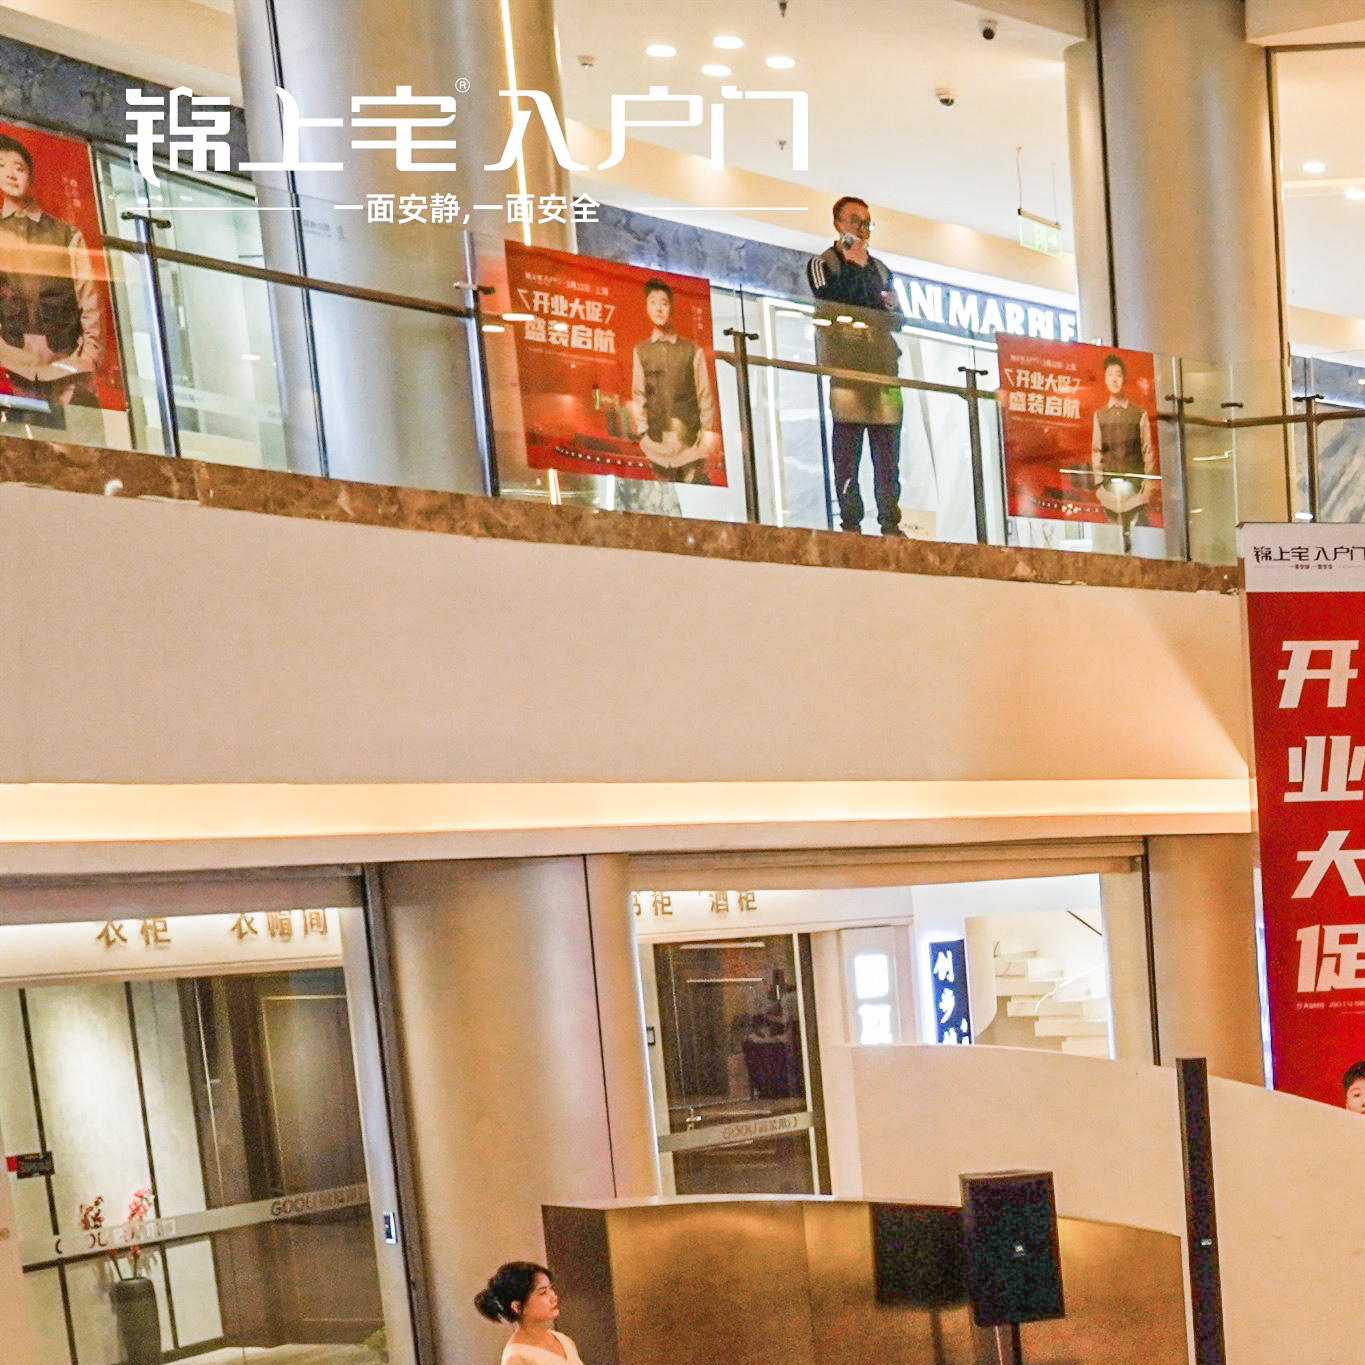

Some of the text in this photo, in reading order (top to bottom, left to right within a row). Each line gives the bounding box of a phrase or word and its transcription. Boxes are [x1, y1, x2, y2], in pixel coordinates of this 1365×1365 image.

[532, 290, 604, 323] 开业大促
[525, 318, 616, 353] 盛装启航
[1016, 369, 1072, 394] 开业大促
[1009, 391, 1081, 419] 盛装启航
